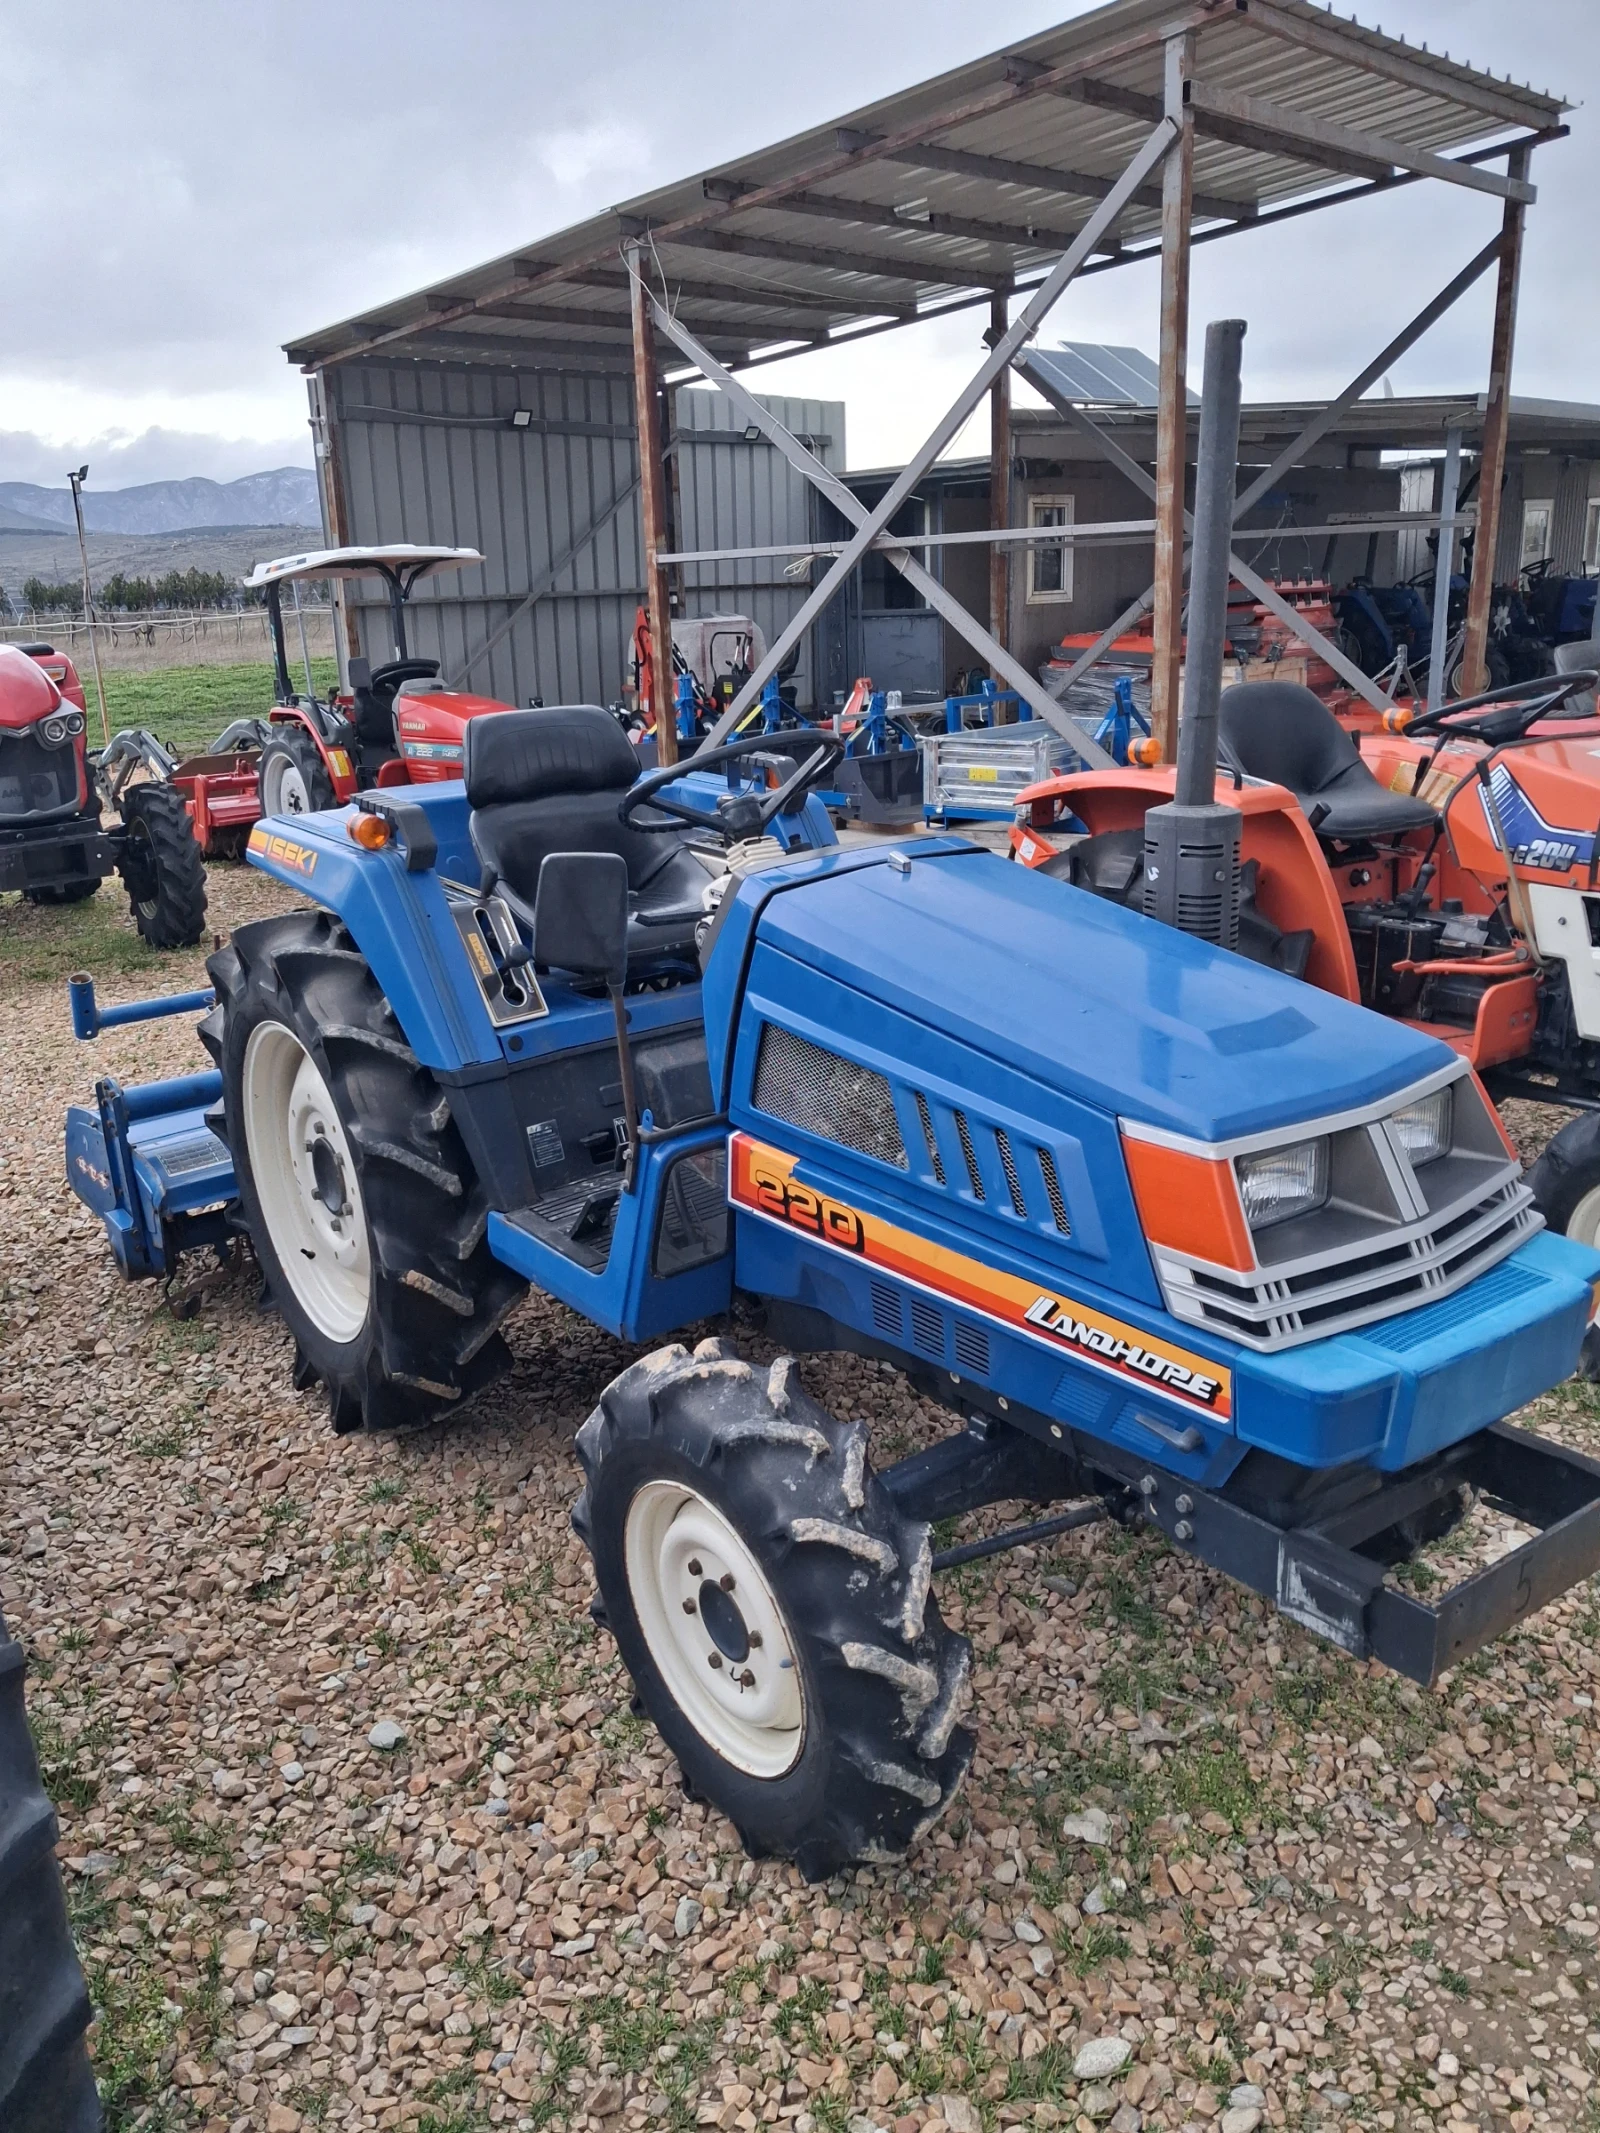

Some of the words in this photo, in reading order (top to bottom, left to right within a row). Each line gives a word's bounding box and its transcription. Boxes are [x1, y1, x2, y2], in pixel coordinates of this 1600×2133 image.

[402, 722, 426, 731] YANMAR
[266, 835, 319, 877] ISEKI
[755, 1168, 864, 1253] 220
[1024, 1295, 1221, 1403] LANDHOPE
